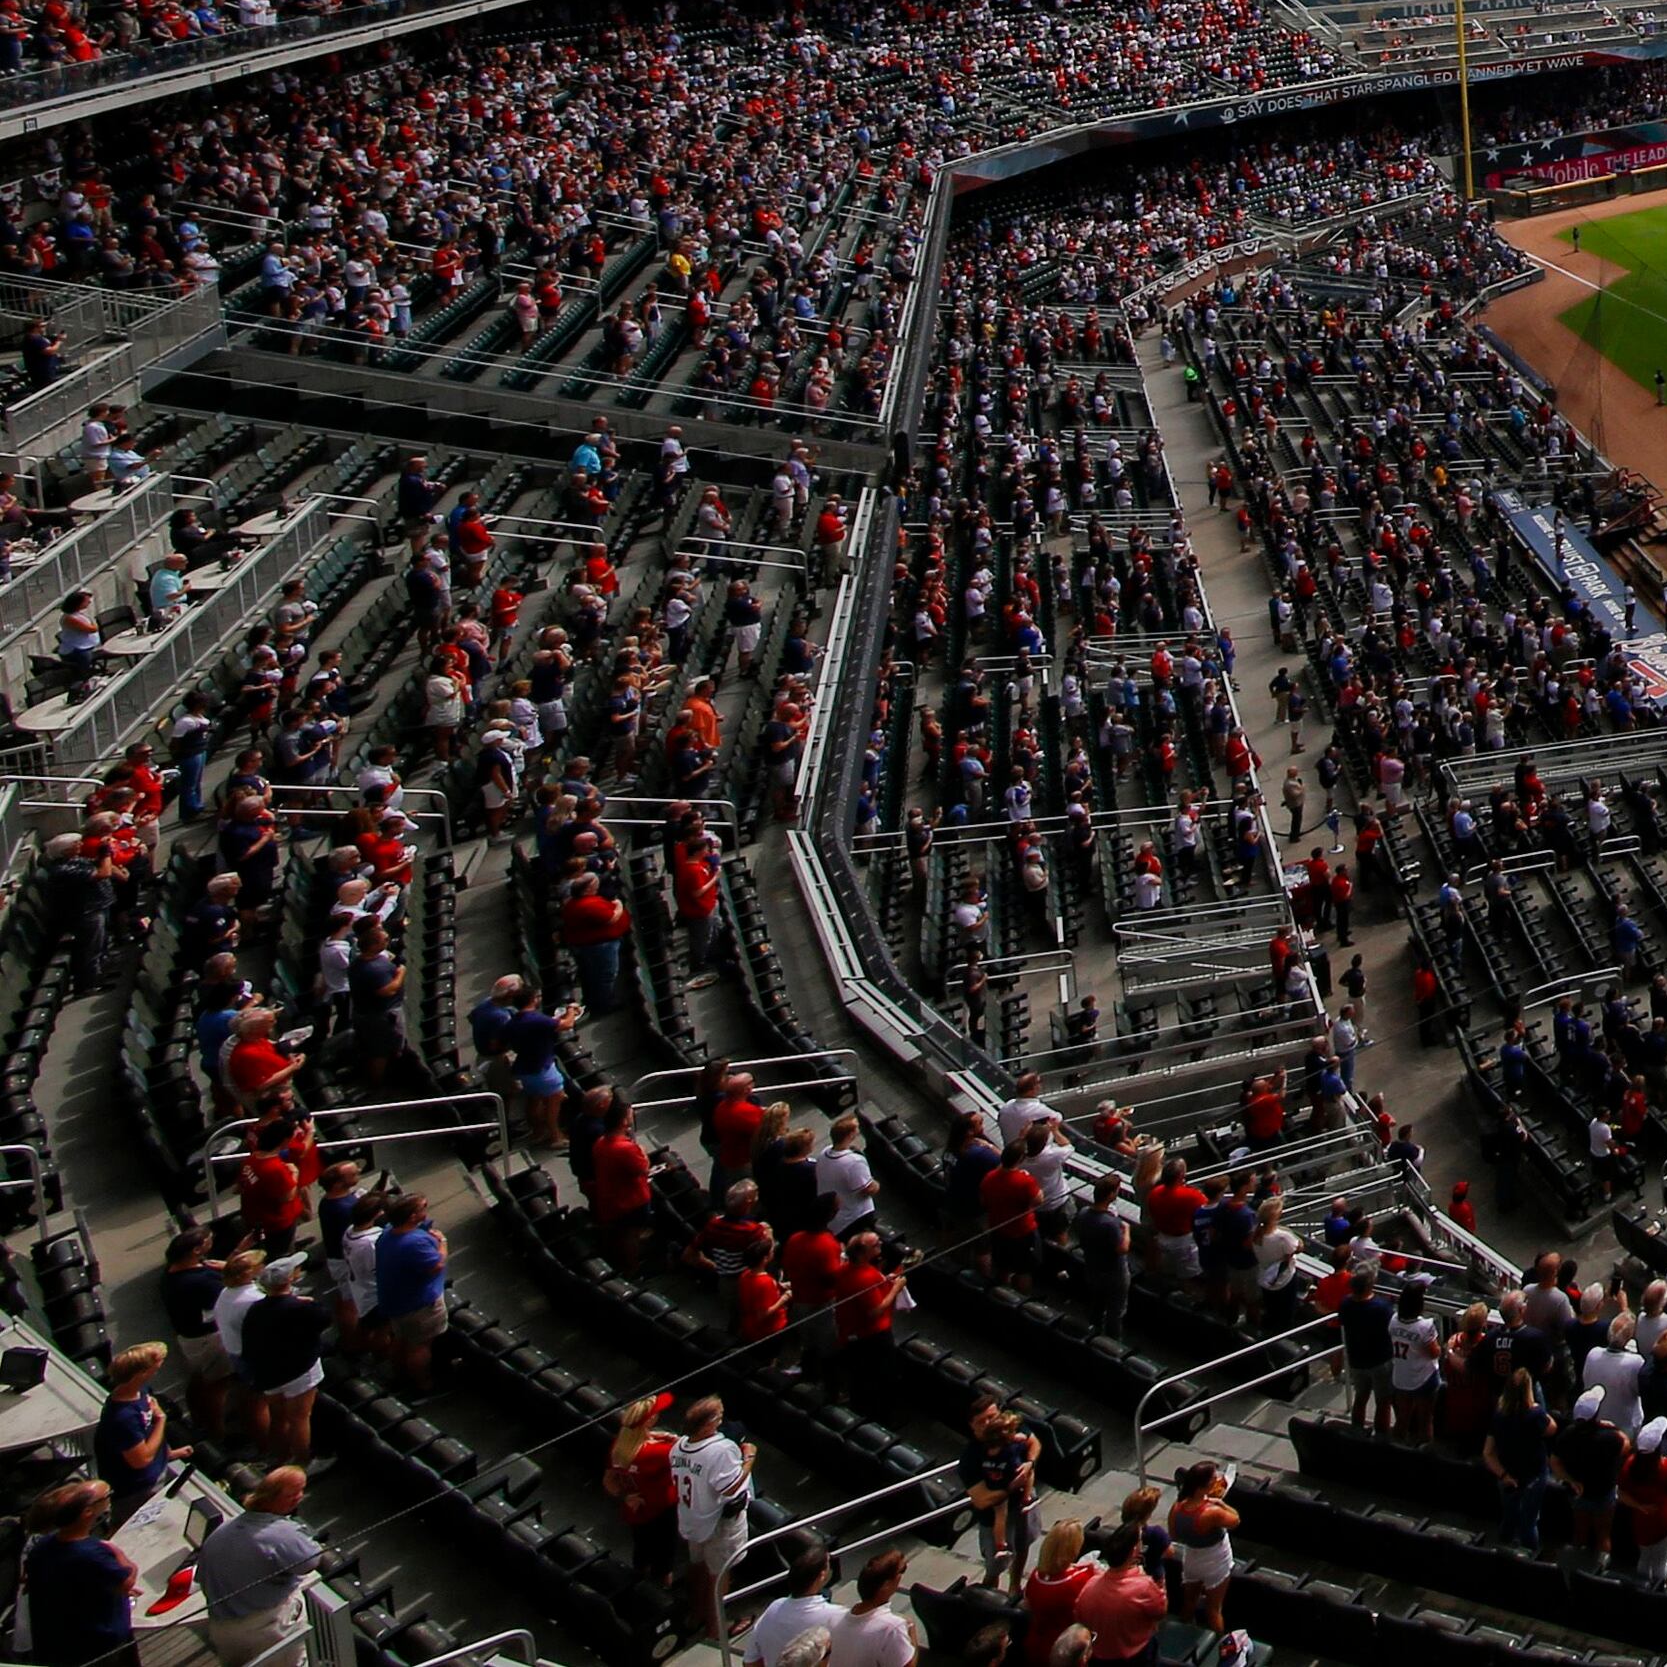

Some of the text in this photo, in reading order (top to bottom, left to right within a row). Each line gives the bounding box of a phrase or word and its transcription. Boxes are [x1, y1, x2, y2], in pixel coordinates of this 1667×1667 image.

[1237, 102, 1265, 119] SAY
[1267, 95, 1303, 113] DOES
[1305, 87, 1339, 105] THAT
[1515, 58, 1543, 76] YET
[1546, 54, 1585, 69] WAVE
[1604, 155, 1631, 171] THE
[1393, 1341, 1409, 1359] 17
[1495, 1337, 1514, 1349] COX
